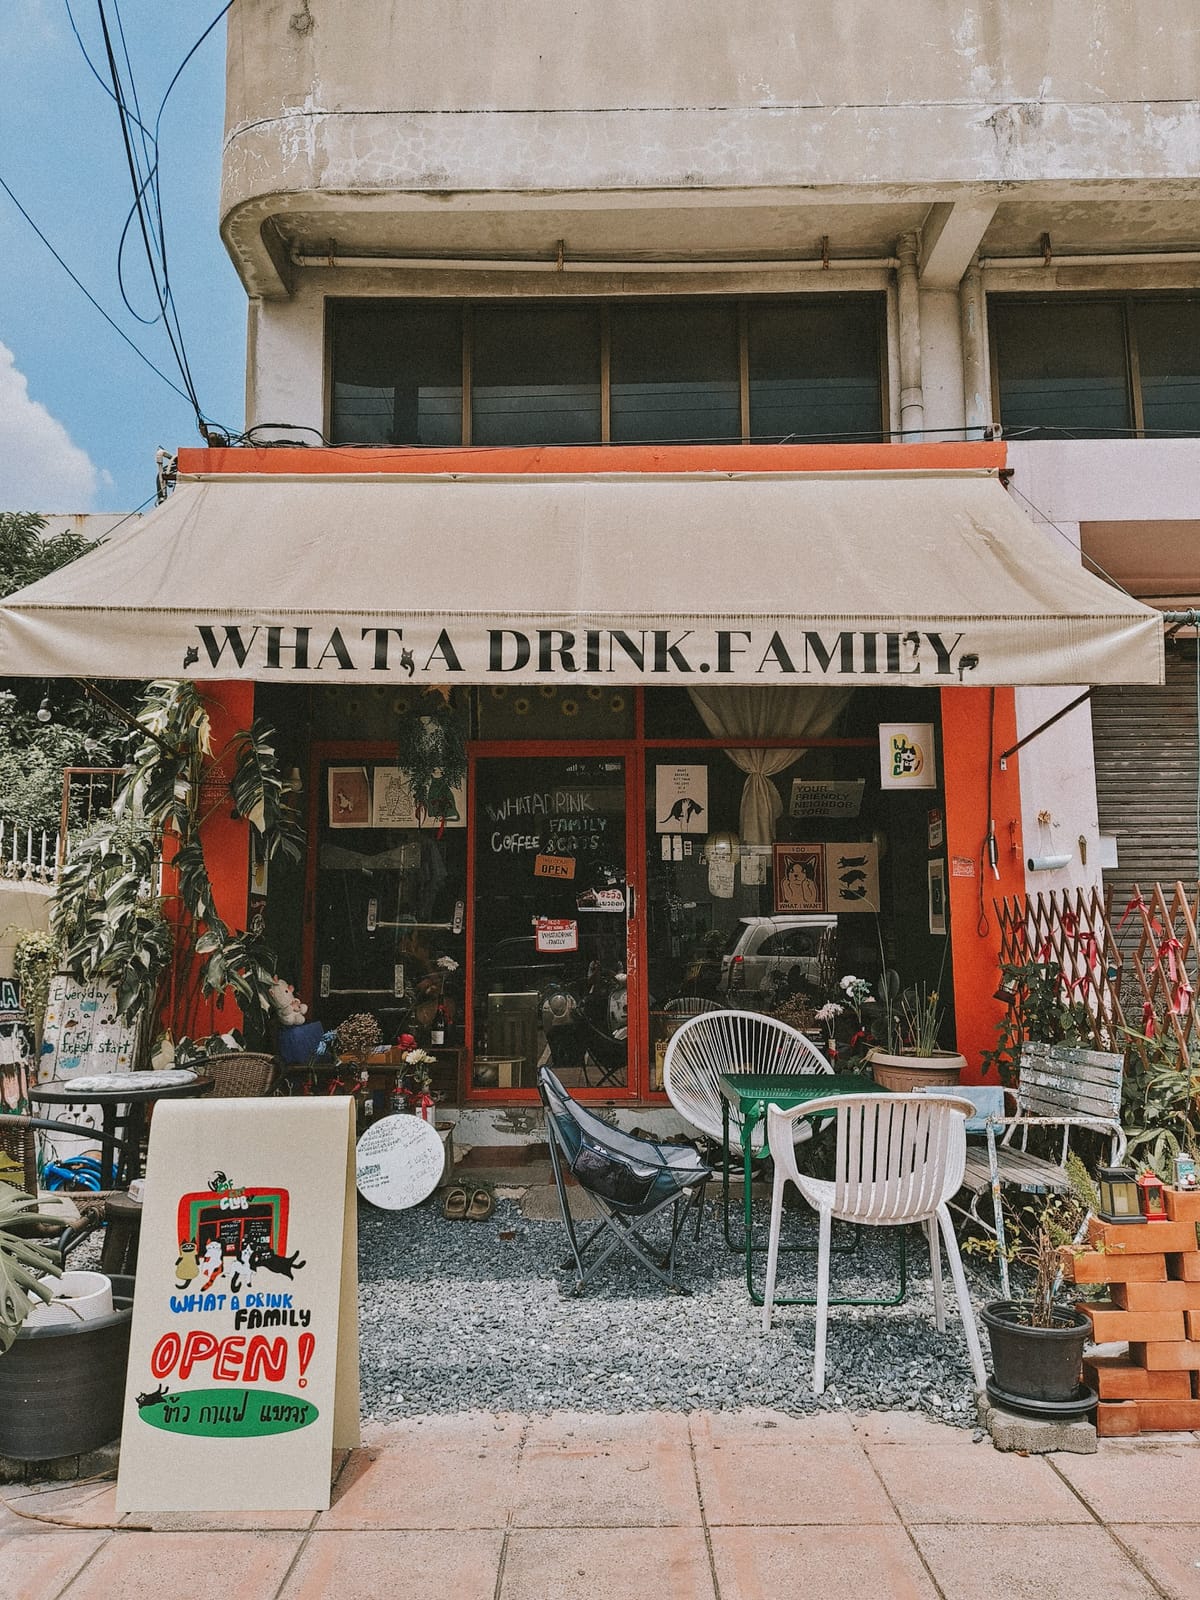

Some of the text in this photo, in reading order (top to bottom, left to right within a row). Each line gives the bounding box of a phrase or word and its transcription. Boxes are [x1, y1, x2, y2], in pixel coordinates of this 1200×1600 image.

[195, 624, 403, 670] WHAT
[421, 627, 464, 672] A
[795, 793, 849, 801] FRIENDLY
[797, 785, 828, 793] YOUR
[491, 832, 541, 853] COFFEE
[541, 864, 569, 875] OPEN
[54, 986, 109, 1001] Everyday
[67, 1007, 76, 1018] is
[61, 1031, 131, 1054] fresh start
[220, 1195, 249, 1211] CLUB
[170, 1291, 293, 1314] WHAT A DRINK
[234, 1308, 311, 1331] FAMILY
[199, 1391, 250, 1425] กาแฟ
